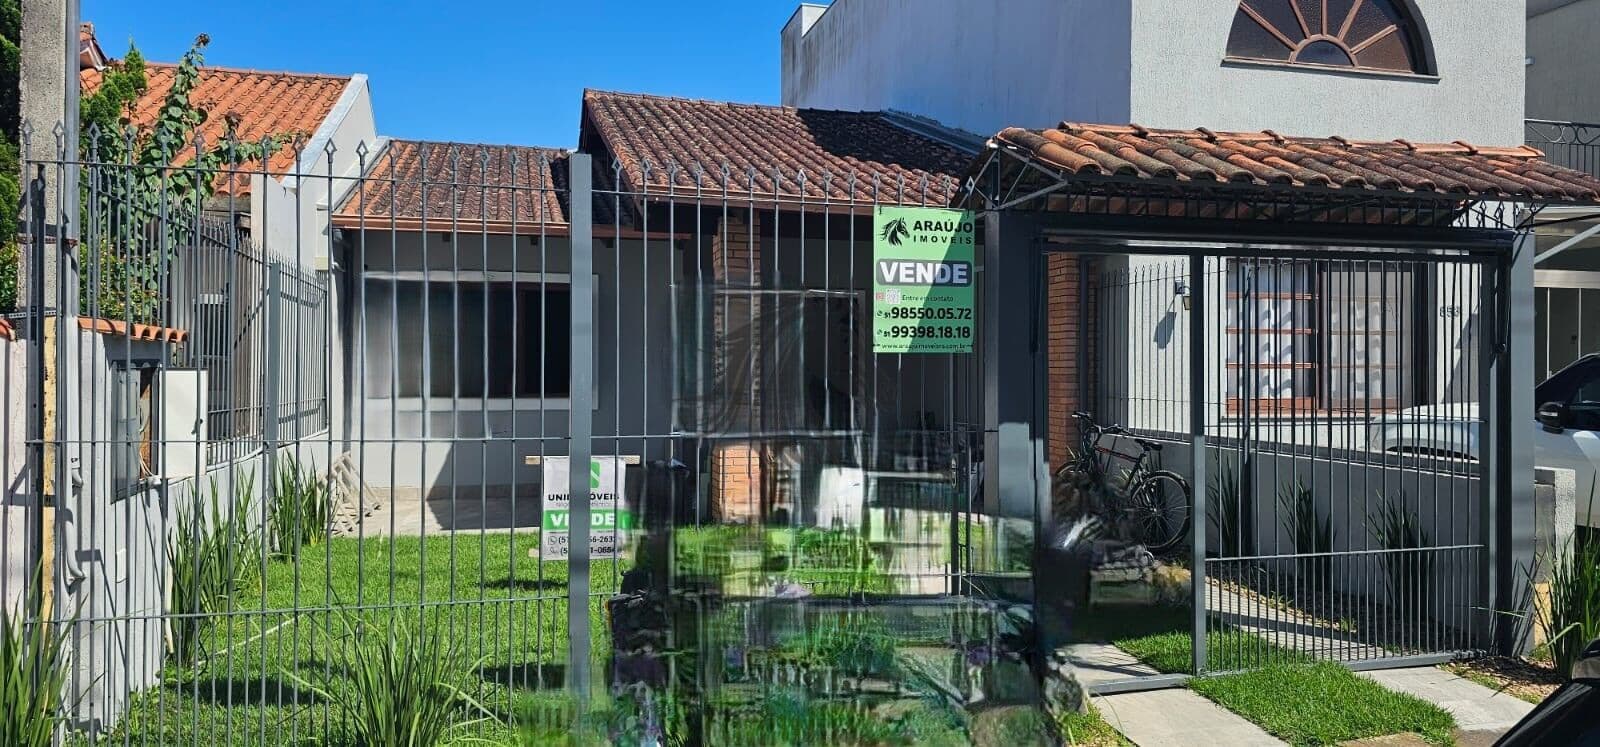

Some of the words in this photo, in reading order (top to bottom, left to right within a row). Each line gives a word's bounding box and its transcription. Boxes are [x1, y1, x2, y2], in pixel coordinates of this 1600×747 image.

[913, 218, 973, 233] ARAÚJO
[879, 262, 968, 284] VENDE
[891, 306, 972, 320] 98550.05.72
[891, 326, 971, 338] 99398.18.18
